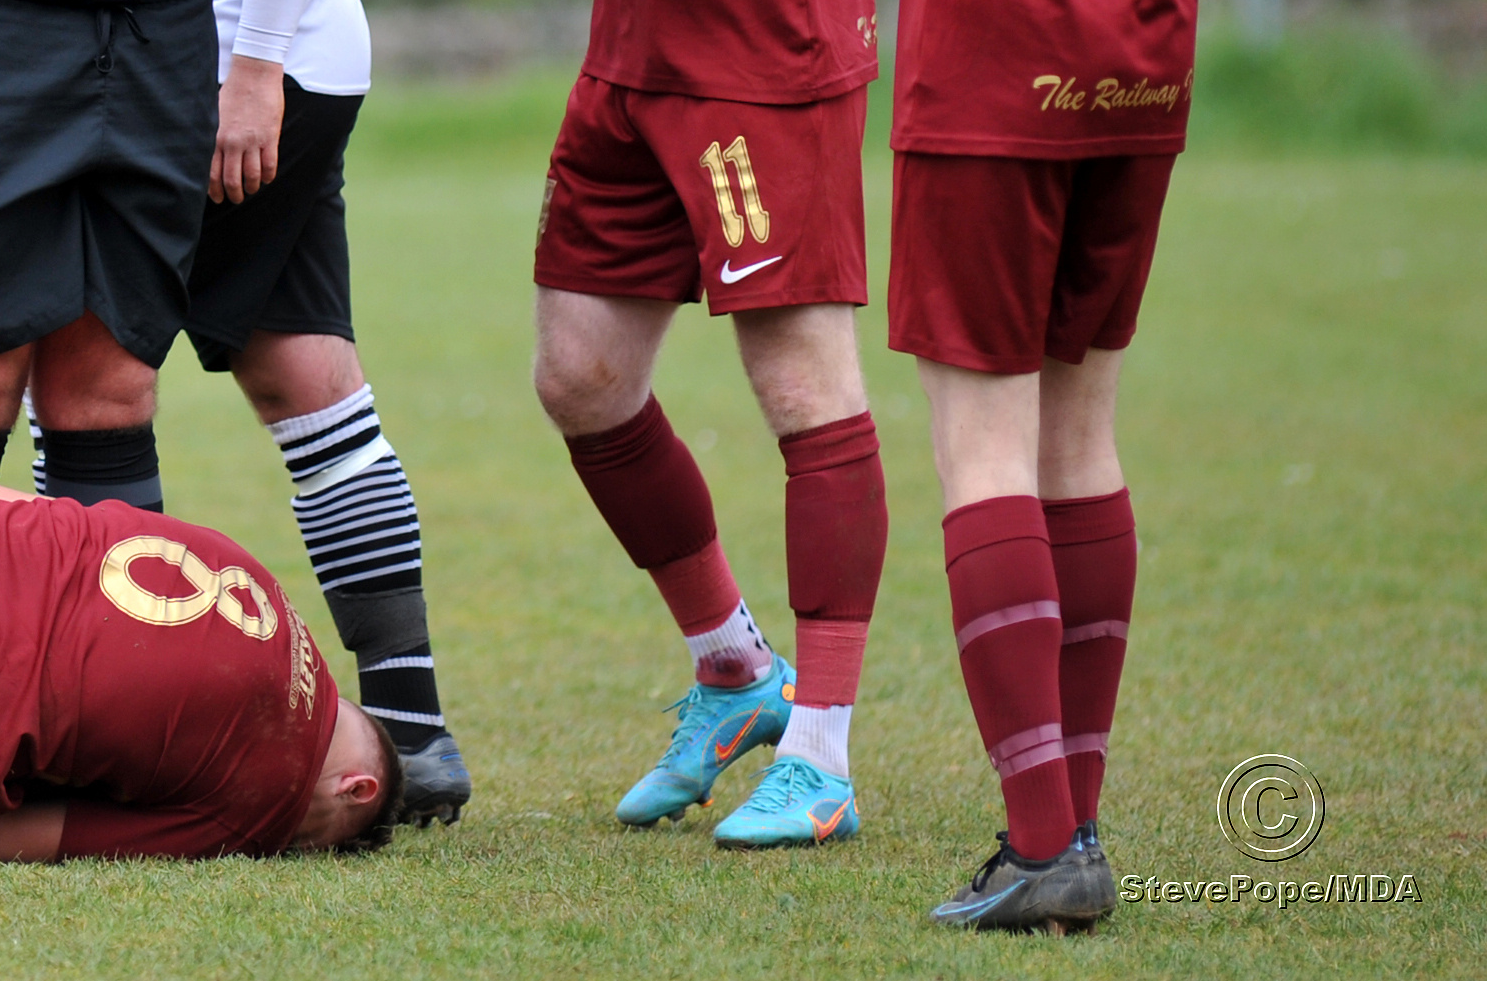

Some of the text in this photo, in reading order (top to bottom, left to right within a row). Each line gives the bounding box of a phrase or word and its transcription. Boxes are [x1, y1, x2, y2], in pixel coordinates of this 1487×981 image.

[1033, 74, 1086, 111] The
[1090, 77, 1180, 113] Railway
[699, 135, 770, 248] 11
[99, 535, 279, 641] 8
